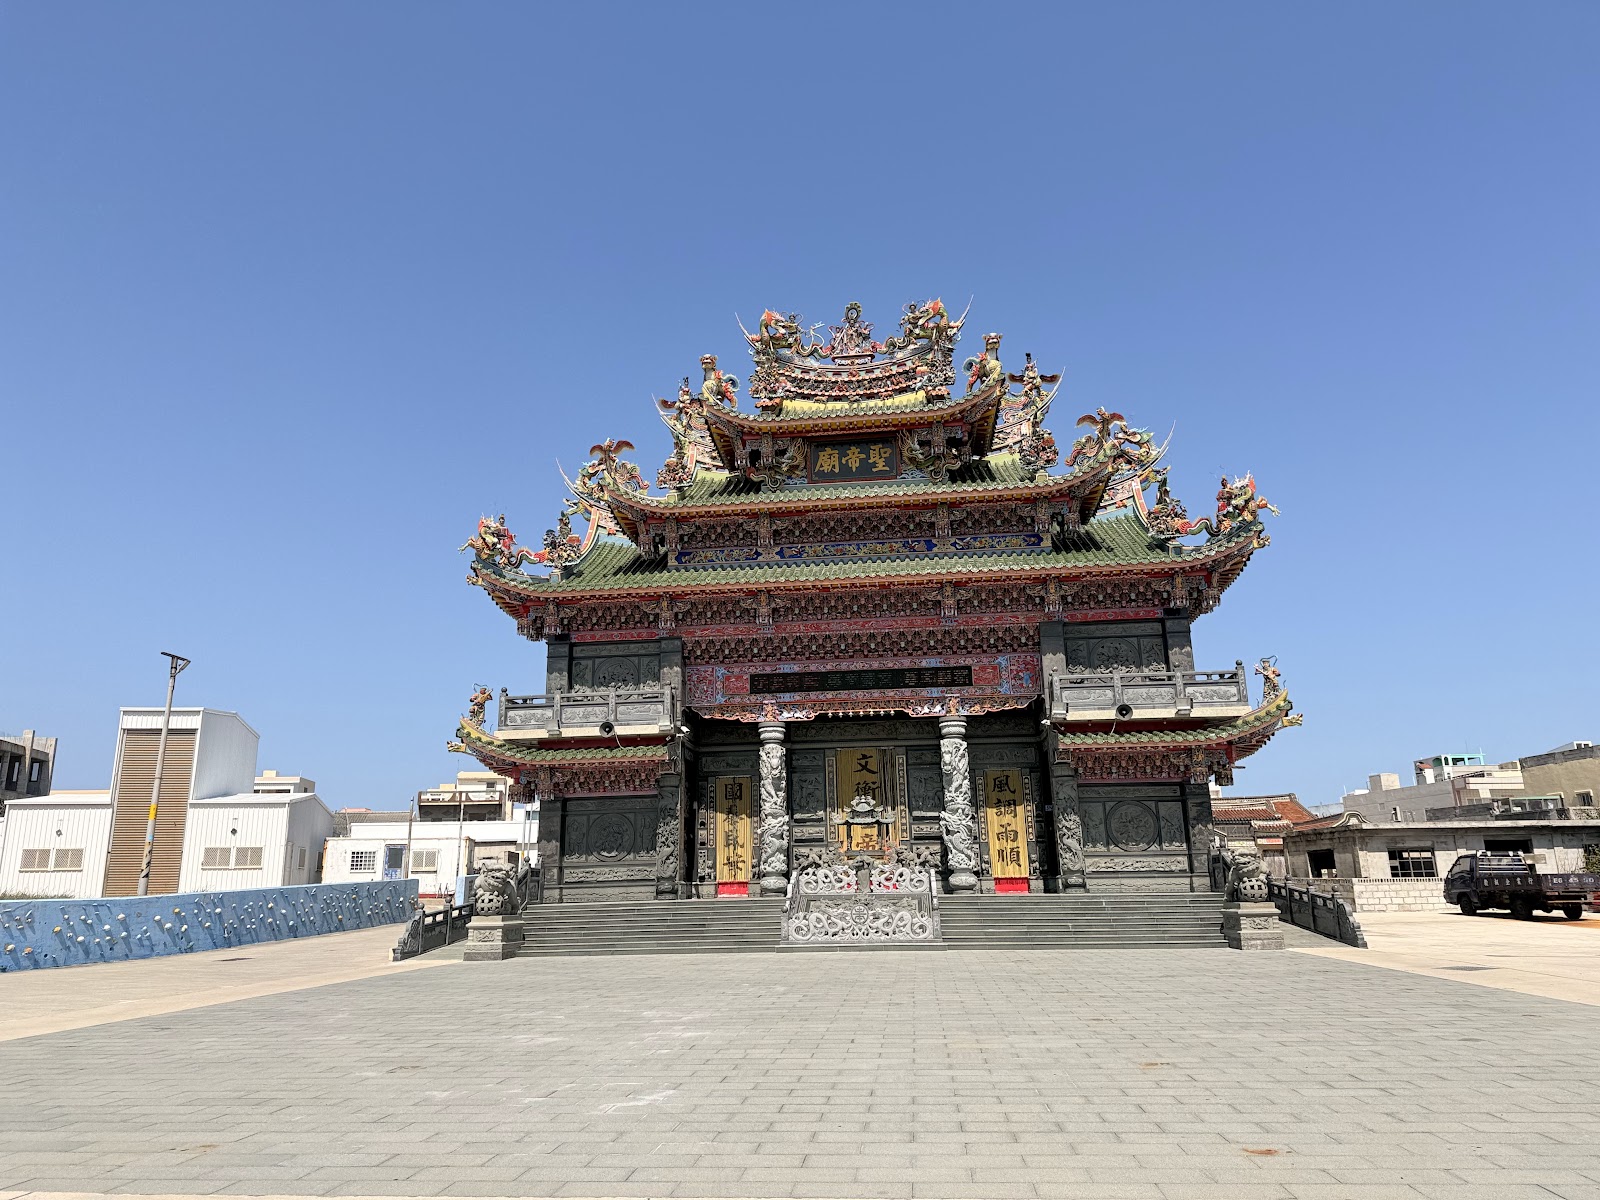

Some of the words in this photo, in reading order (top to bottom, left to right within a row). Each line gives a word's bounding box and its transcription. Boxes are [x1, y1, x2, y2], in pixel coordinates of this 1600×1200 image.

[814, 444, 893, 473] 聖帝廟
[853, 753, 880, 851] 文衡帝
[992, 774, 1022, 867] 風調雨順
